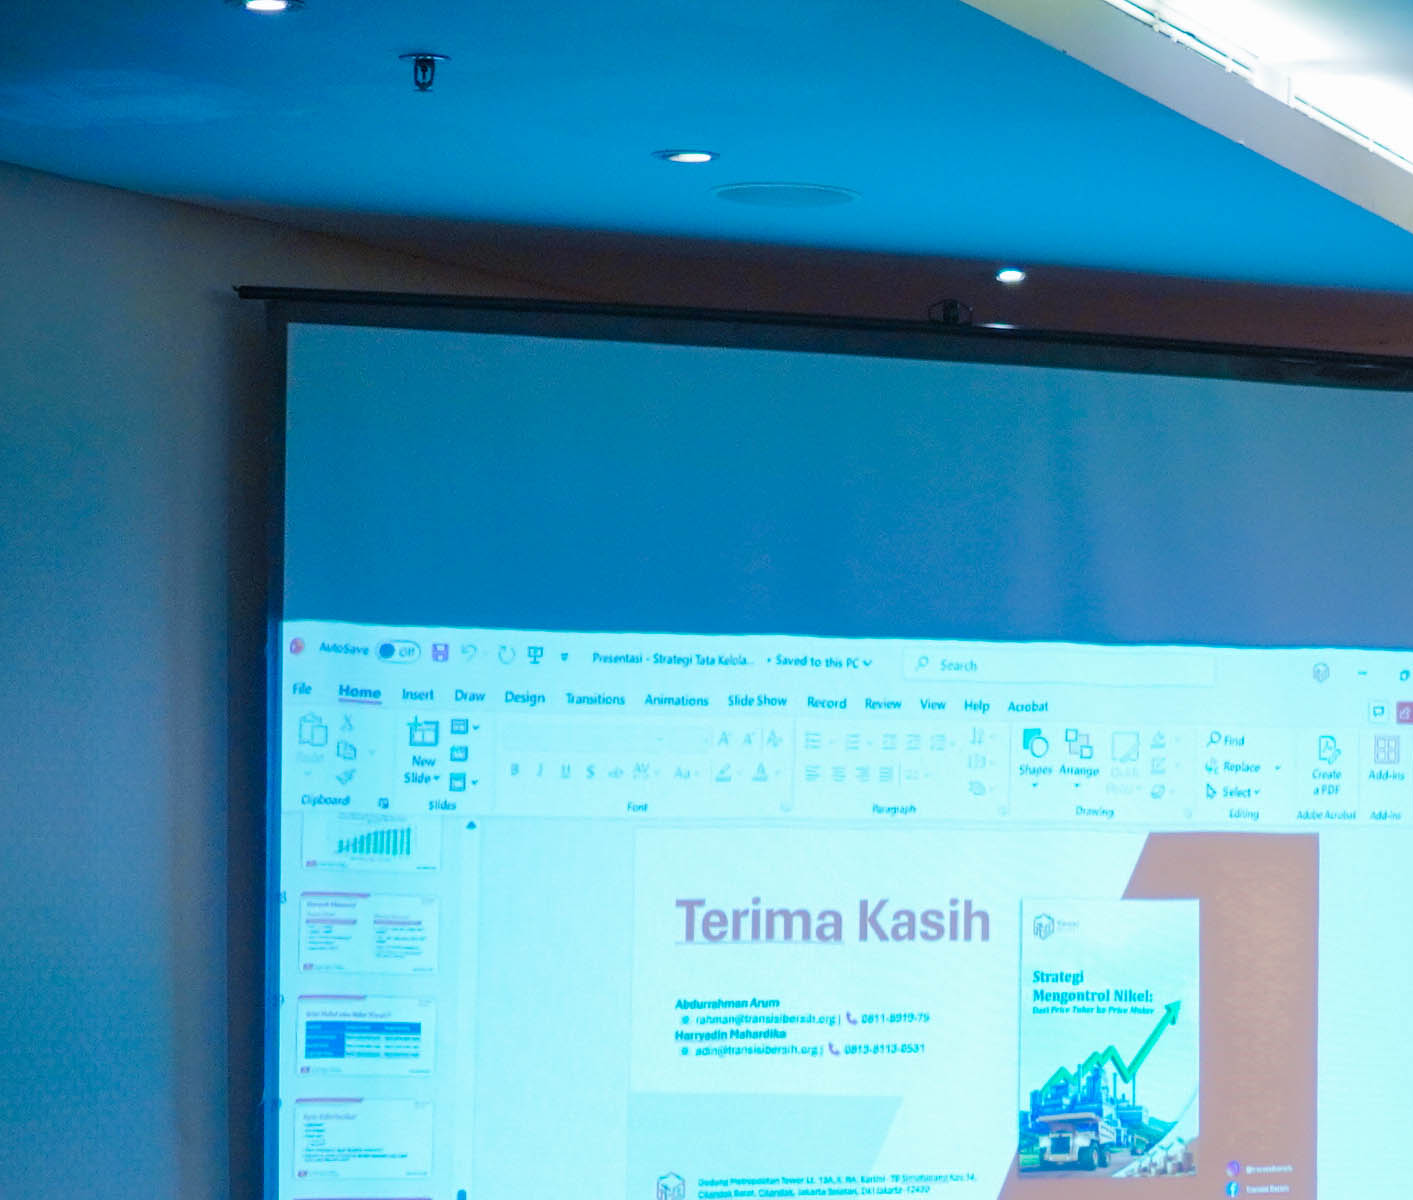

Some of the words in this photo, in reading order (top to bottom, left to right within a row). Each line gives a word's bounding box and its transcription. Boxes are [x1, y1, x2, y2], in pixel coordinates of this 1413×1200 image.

[319, 641, 369, 656] AutoSave
[592, 652, 643, 666] Presentasi
[652, 652, 692, 668] Strategi
[775, 653, 808, 668] Saved
[810, 656, 822, 668] to
[824, 655, 843, 669] this
[845, 657, 860, 670] PC
[940, 658, 978, 673] Search
[291, 682, 313, 697] File
[338, 683, 382, 700] Home
[402, 687, 435, 702] Insert
[455, 689, 486, 703] Draw
[504, 690, 546, 708] Design
[566, 691, 626, 708] Transitions
[644, 693, 710, 709] Animations
[728, 694, 755, 708] Slide
[756, 694, 788, 709] Show
[806, 696, 848, 711] Record
[864, 698, 902, 711] Review
[919, 698, 946, 712] View
[964, 699, 990, 714] Help
[1007, 700, 1049, 714] Acrobat
[1223, 734, 1246, 748] Find
[411, 755, 437, 768] New
[1223, 761, 1261, 775] Replace
[1018, 763, 1053, 779] Shapes
[1059, 764, 1100, 779] Arrange
[1311, 767, 1342, 781] Create
[1368, 768, 1406, 782] Add-ins
[403, 772, 431, 785] Slide
[1222, 786, 1252, 799] Select
[1321, 783, 1341, 797] PDF
[300, 793, 351, 809] Clipboard
[427, 799, 457, 812] Slides
[627, 800, 648, 813] Font
[1075, 804, 1116, 819] Drawing
[1228, 808, 1260, 822] Editing
[675, 896, 843, 943] Terima
[858, 897, 991, 943] Kasih
[1032, 970, 1084, 986] Strategi
[675, 998, 748, 1010] Abdurrahman
[750, 996, 780, 1009] Arum
[1032, 989, 1110, 1005] Mengontrol
[1113, 989, 1153, 1003] Nikel:
